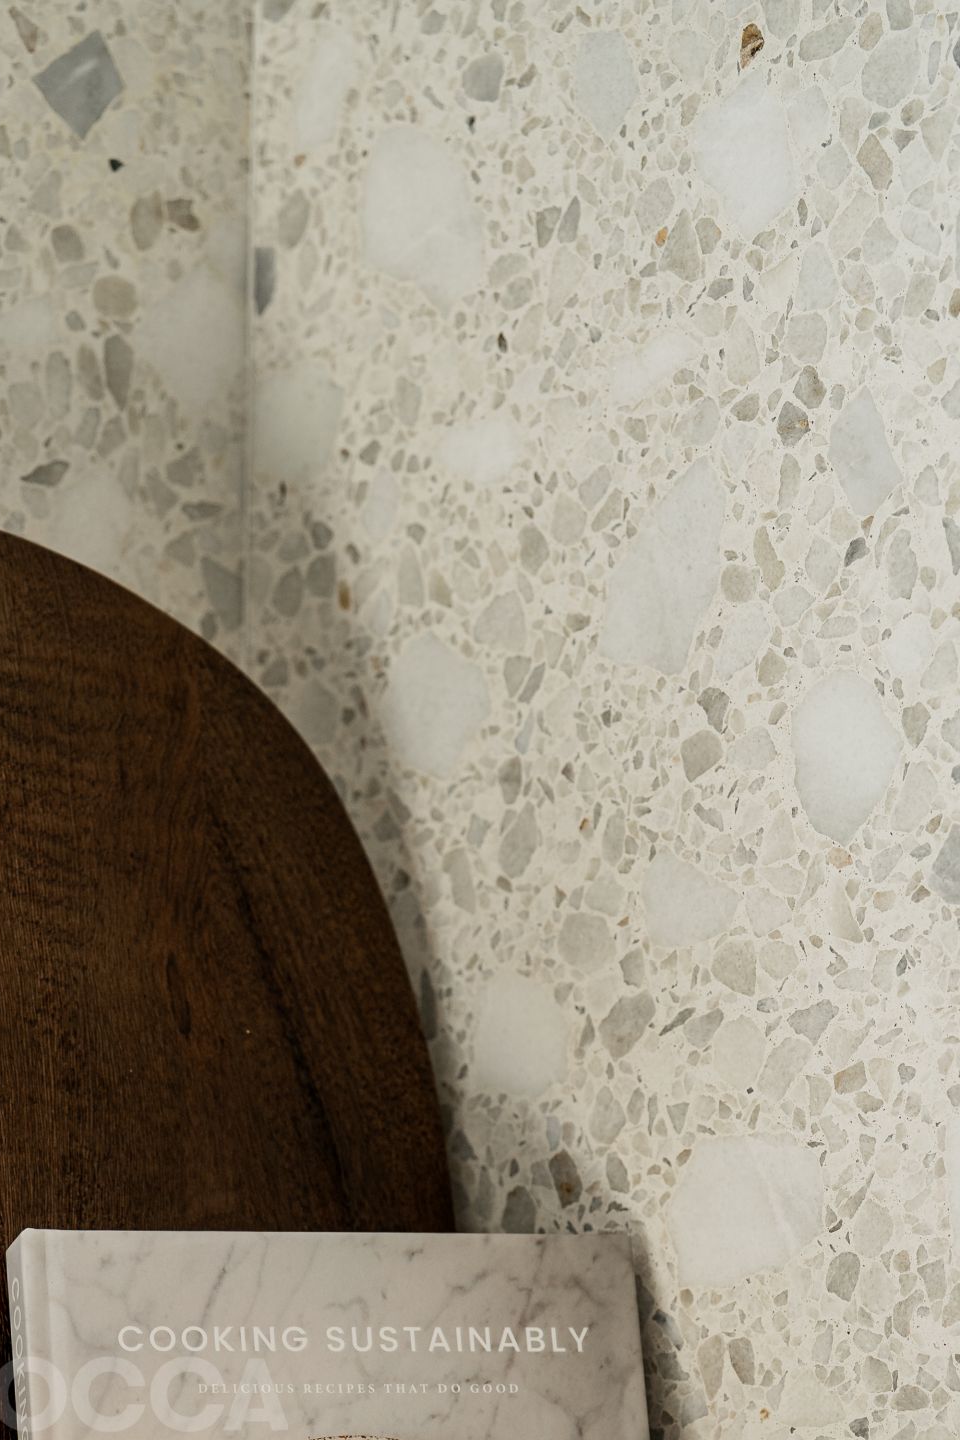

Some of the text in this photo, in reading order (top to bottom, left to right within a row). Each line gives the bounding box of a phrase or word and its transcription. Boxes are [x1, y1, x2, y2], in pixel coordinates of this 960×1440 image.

[117, 1325, 590, 1353] COOKING SUSTAINABLY
[197, 1383, 520, 1395] DELICIOUS RECIPES THAT DO GOOD
